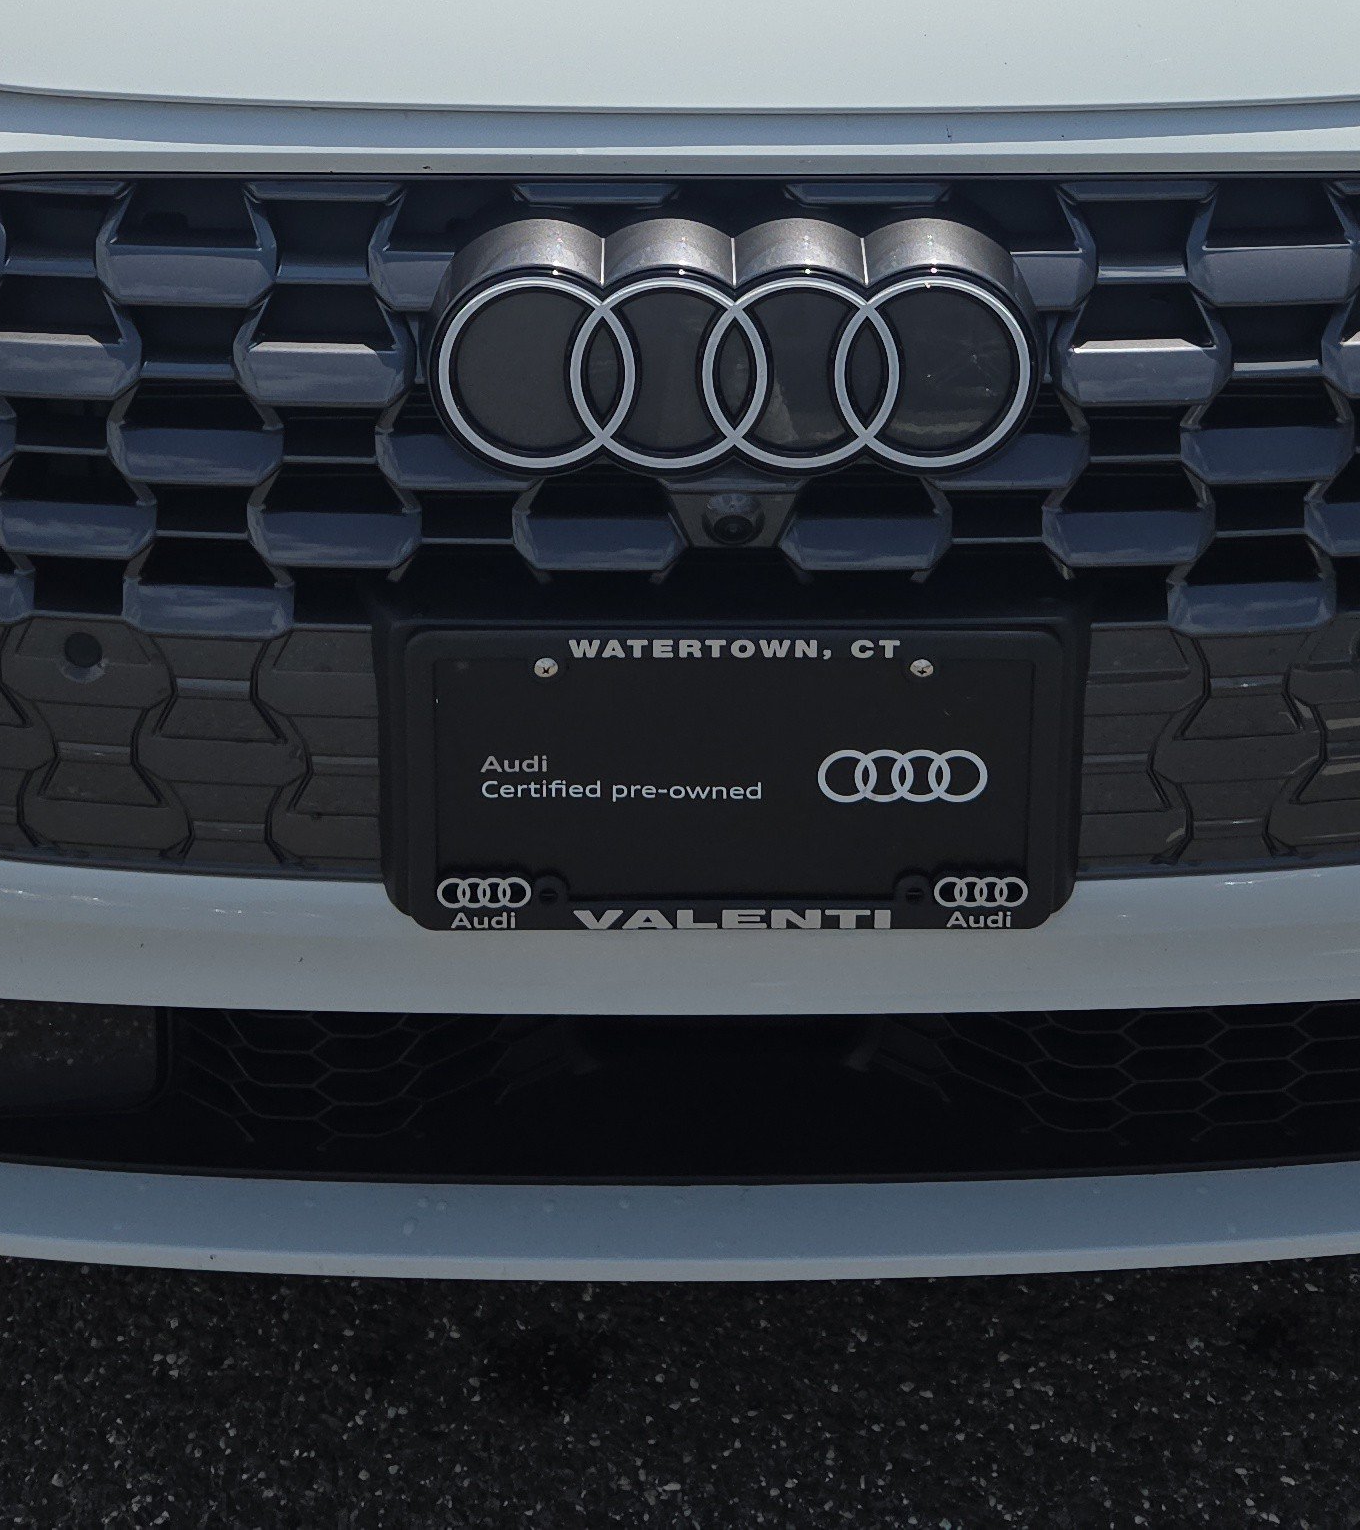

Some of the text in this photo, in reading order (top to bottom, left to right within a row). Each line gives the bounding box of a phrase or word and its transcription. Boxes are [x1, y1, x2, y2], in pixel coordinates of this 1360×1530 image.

[568, 639, 902, 660] WATERTOWN, CT
[480, 755, 548, 773] Audi
[481, 779, 763, 801] Certified pre-owned
[450, 912, 517, 929] Audi
[573, 909, 892, 930] VALENTI
[946, 912, 1012, 929] Audi
